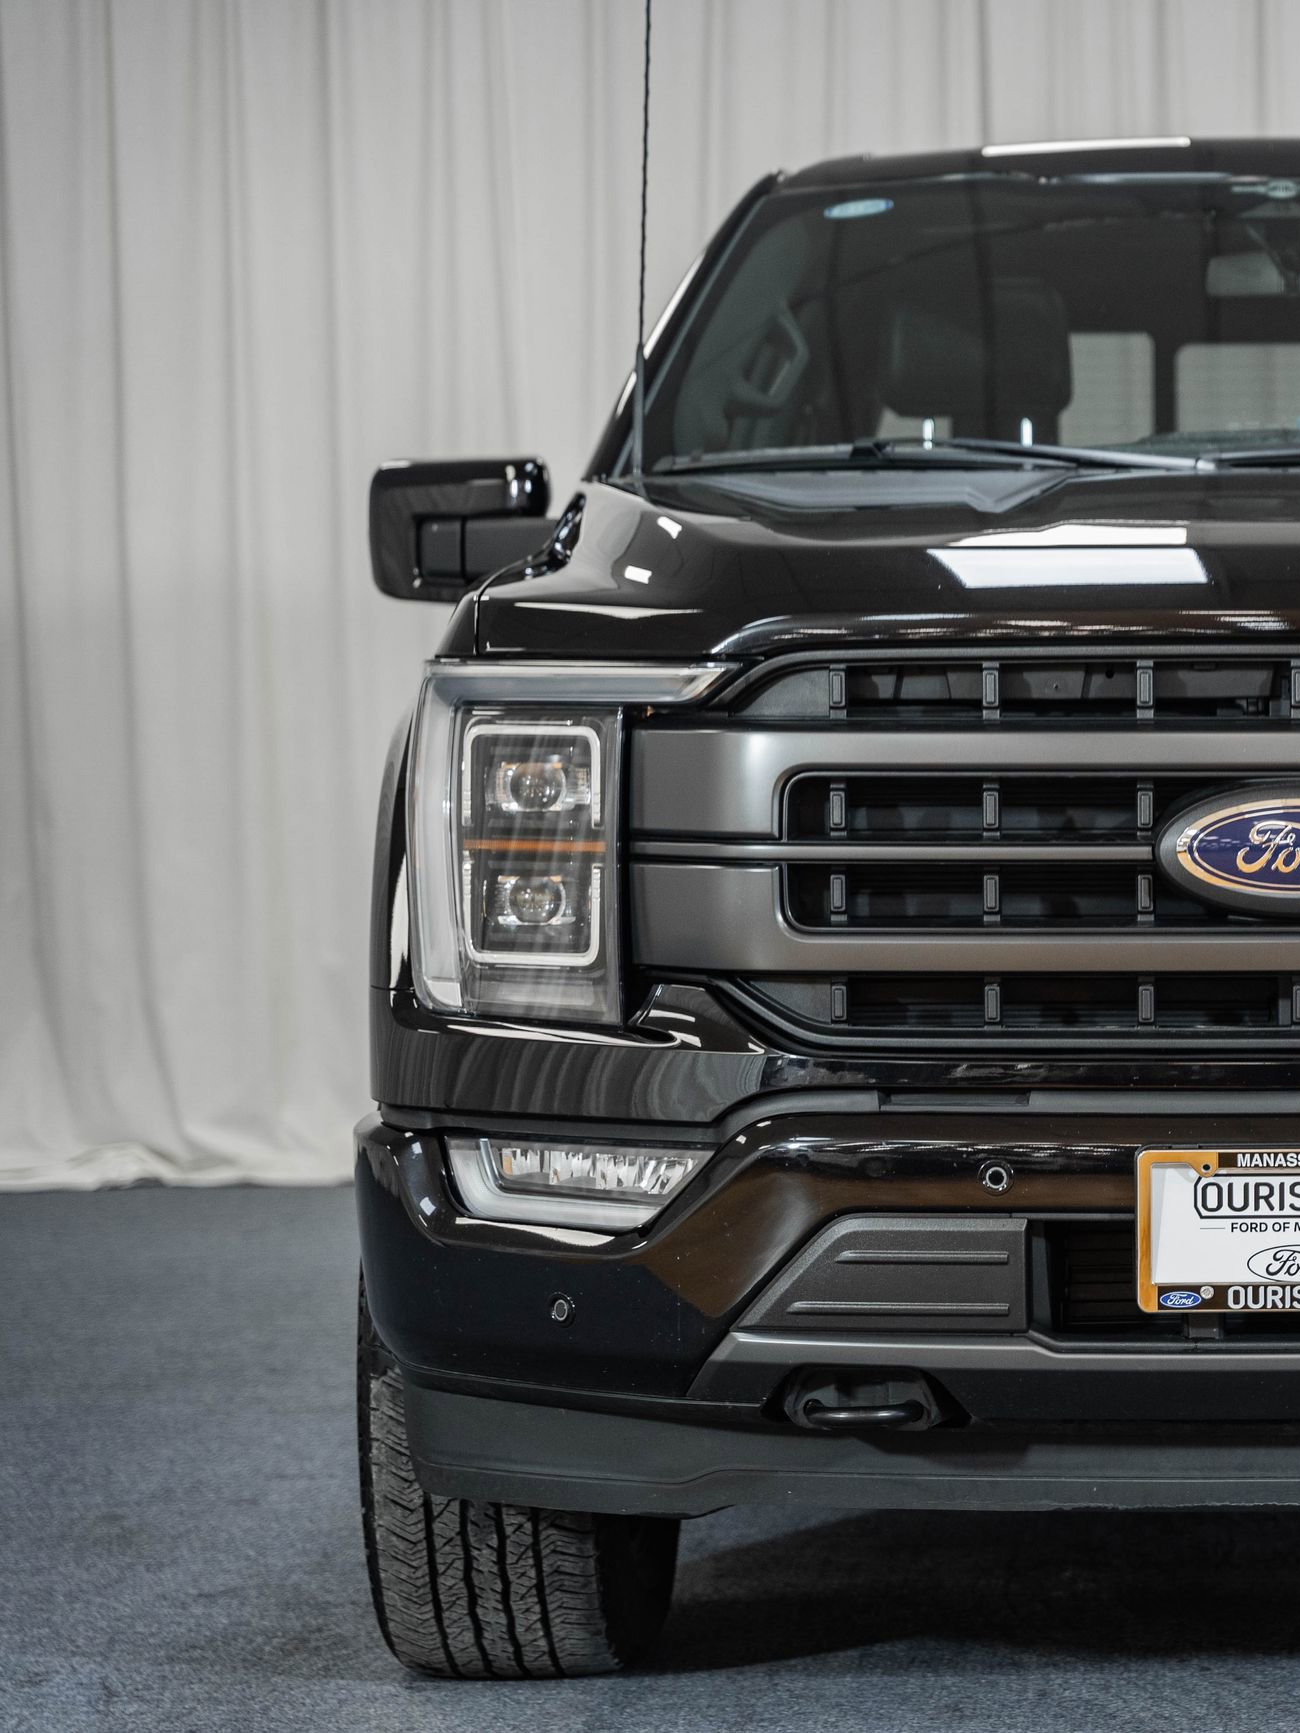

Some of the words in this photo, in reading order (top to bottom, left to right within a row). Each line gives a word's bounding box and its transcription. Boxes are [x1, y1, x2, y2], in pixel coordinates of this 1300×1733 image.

[1230, 1222, 1268, 1233] FORD
[1271, 1222, 1290, 1233] OF
[1167, 1293, 1194, 1305] Ford
